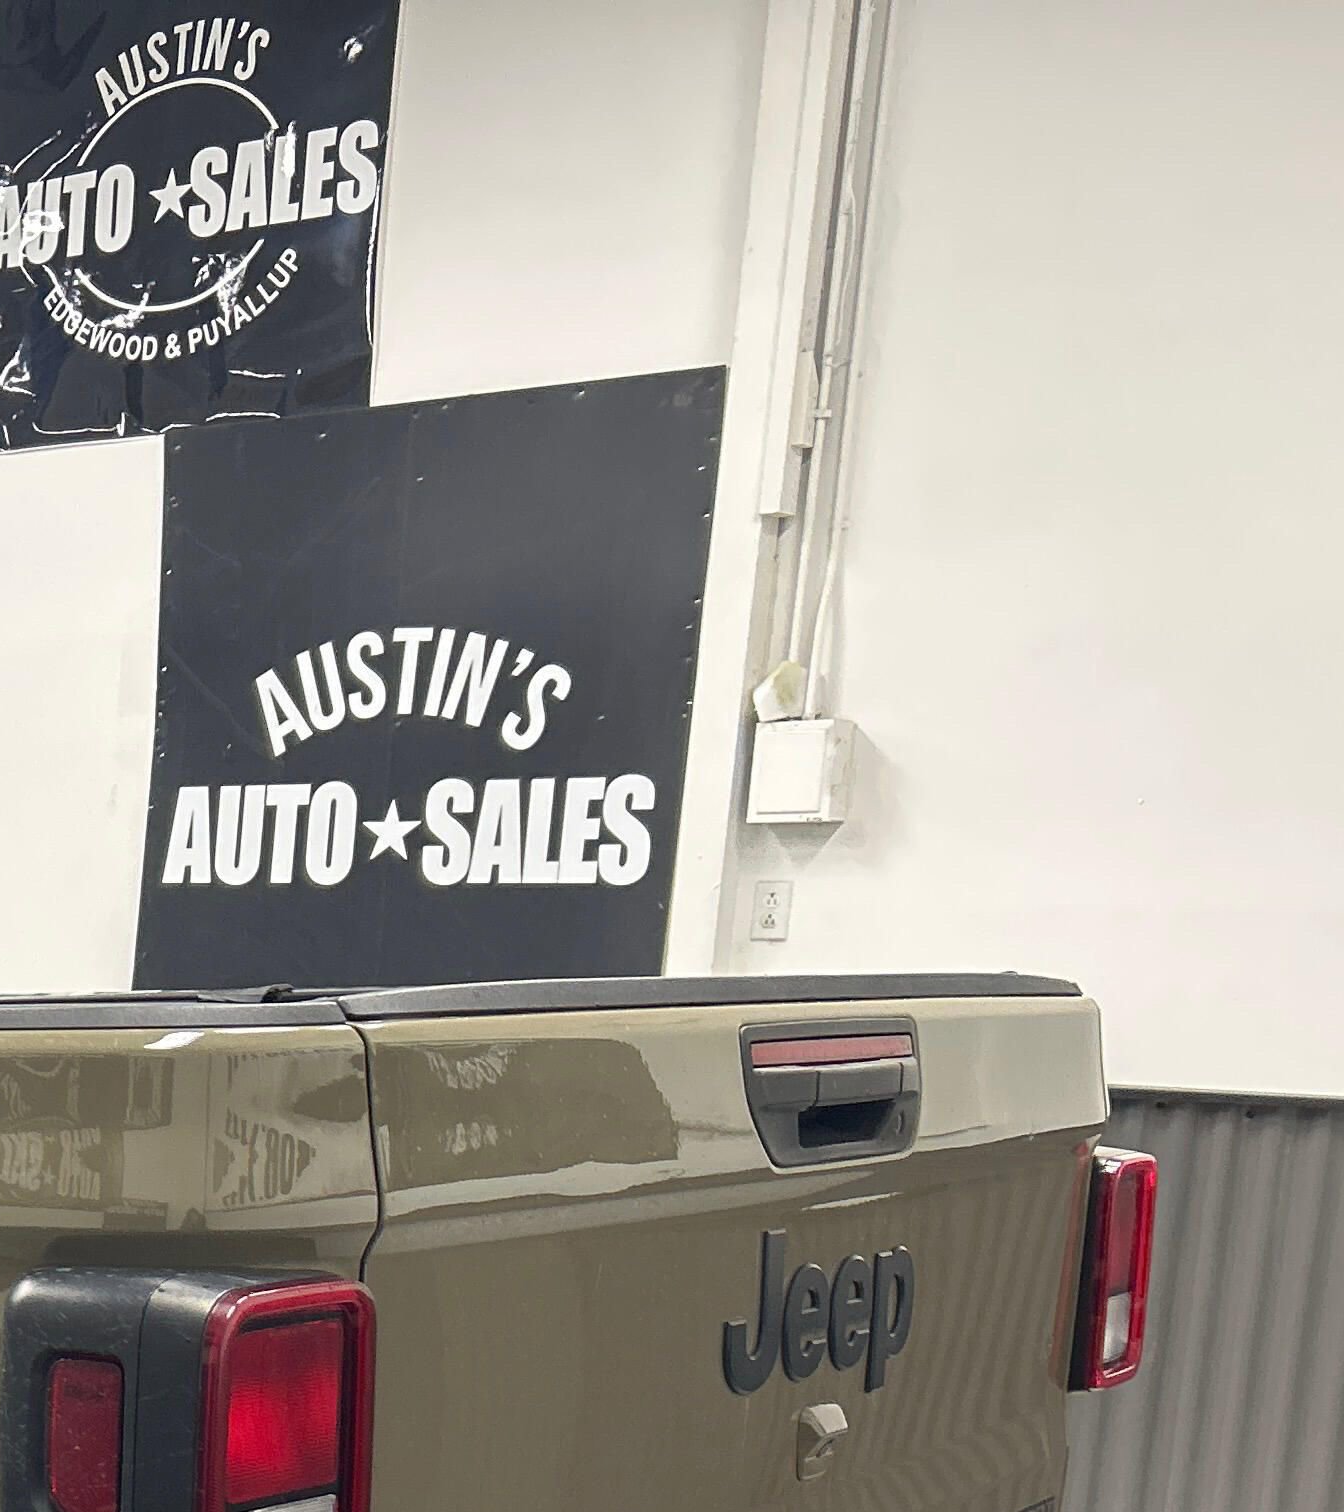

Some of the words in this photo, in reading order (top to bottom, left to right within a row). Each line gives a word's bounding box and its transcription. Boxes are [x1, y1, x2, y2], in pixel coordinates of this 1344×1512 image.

[95, 18, 270, 114] AUSTIN'S
[189, 120, 381, 239] SALES
[44, 288, 158, 361] EDGEWOOD
[164, 337, 182, 359] &
[188, 247, 300, 354] PUYALLUP
[256, 627, 572, 757] AUSTIN'S
[161, 780, 358, 885] AUTO
[422, 774, 656, 886] SALES
[722, 1228, 914, 1395] Jeep
